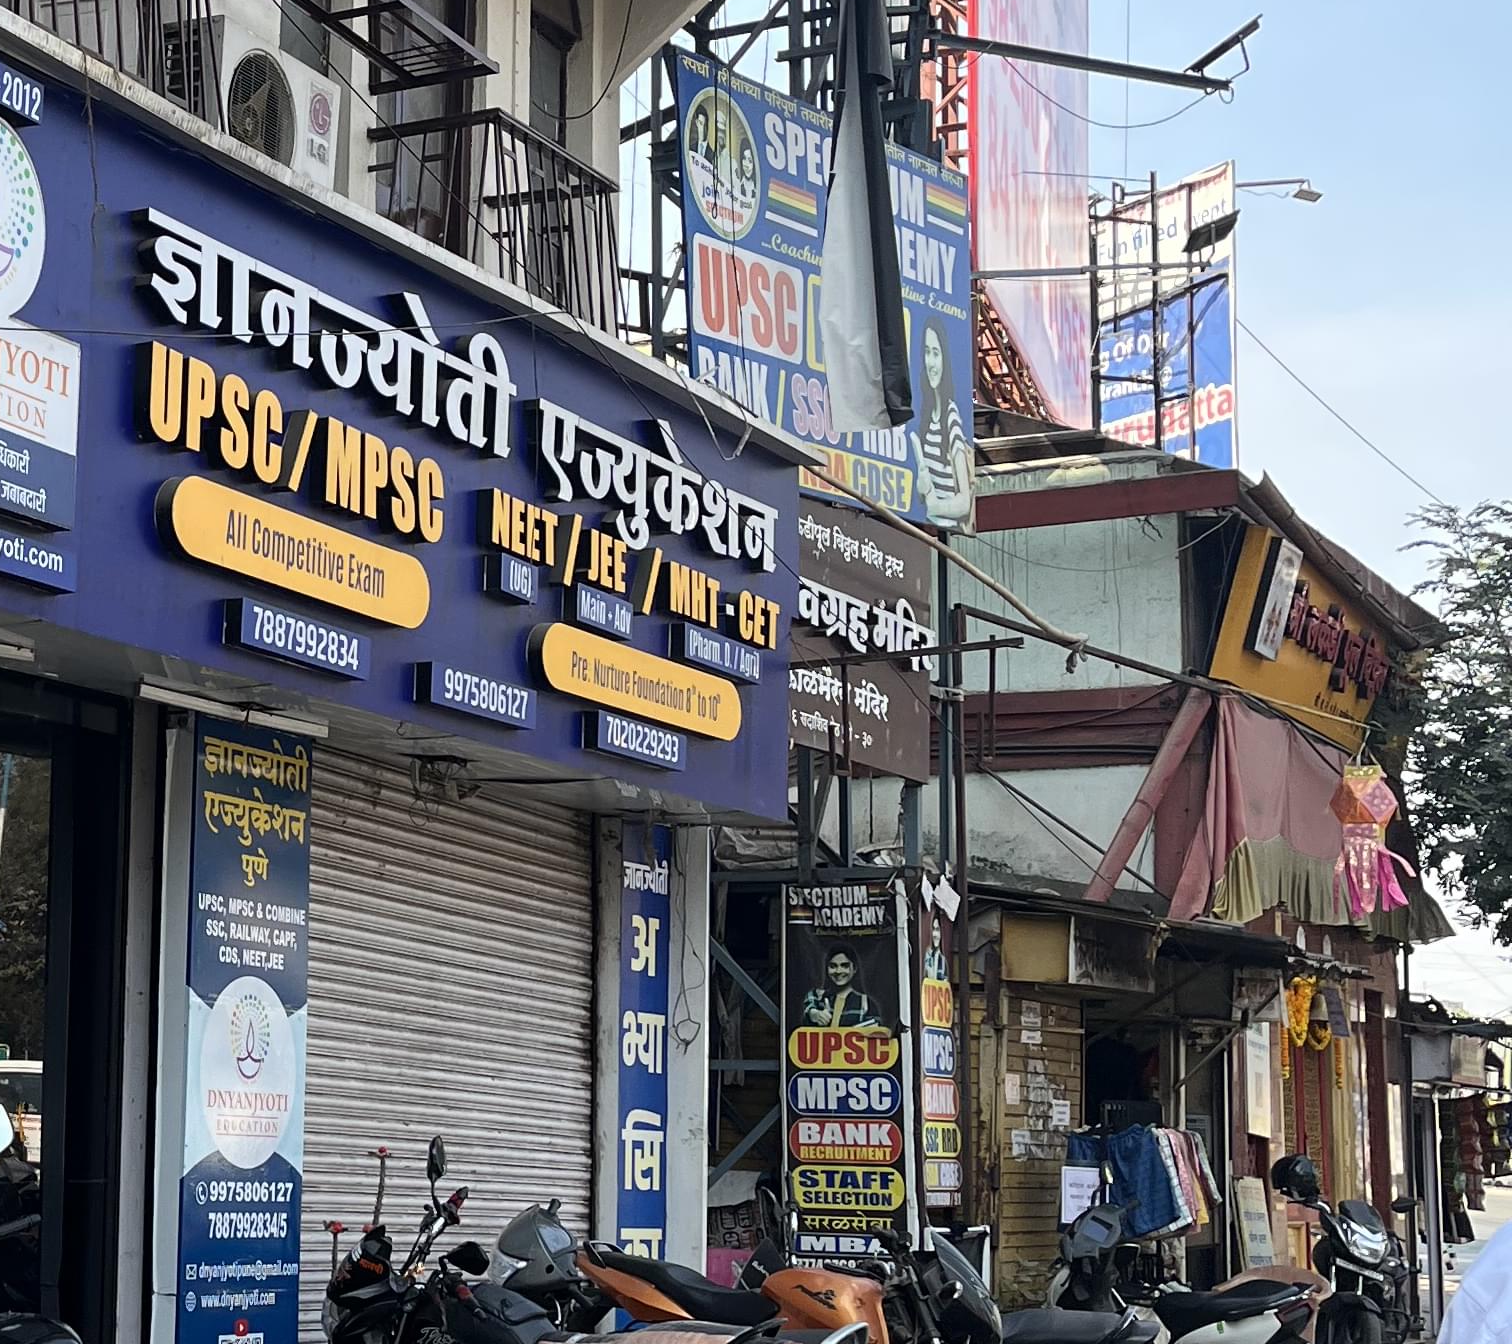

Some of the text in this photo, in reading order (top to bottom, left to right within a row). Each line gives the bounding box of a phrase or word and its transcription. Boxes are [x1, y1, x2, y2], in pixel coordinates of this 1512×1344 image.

[698, 243, 798, 357] UPSC
[928, 290, 967, 321] Exams
[146, 207, 780, 573] ज्ञानज्योती एज्युकेशन
[698, 344, 771, 423] BANK
[150, 341, 445, 544] UPSC MPSC
[0, 479, 47, 514] जबाबदारी
[852, 459, 908, 510] CDSE
[226, 509, 385, 599] All Competitive Exam
[491, 488, 781, 650] NEET JEE MHT CET
[861, 538, 885, 572] मंदिर
[580, 590, 632, 635] Main Adv
[253, 605, 529, 721] 7887992834 9975806127
[593, 659, 707, 718] Nurture Foundation to
[854, 679, 889, 722] मंदिर
[606, 716, 679, 763] 7020229293
[203, 735, 310, 793] ज्ञानज्योती
[203, 787, 306, 846] एज्युकेशन
[241, 848, 269, 887] पुणे
[789, 885, 868, 907] SPECTRUM
[814, 905, 886, 928] ACADEMY
[924, 984, 952, 1024] UPSC
[796, 1031, 890, 1065] UPSC
[925, 1032, 954, 1074] MPSC
[207, 1089, 289, 1115] DNYANJYOTI
[796, 1077, 892, 1111] MPSC
[925, 1082, 956, 1116] BANK
[216, 1118, 279, 1134] EDUCATION
[798, 1122, 893, 1146] BANK
[799, 1145, 893, 1161] RECRUITMENT
[209, 1181, 294, 1203] 9975806127
[799, 1169, 896, 1190] STAFF
[802, 1190, 893, 1207] SELECTION
[208, 1212, 288, 1239] 7887992834/5
[799, 1236, 890, 1254] MBA
